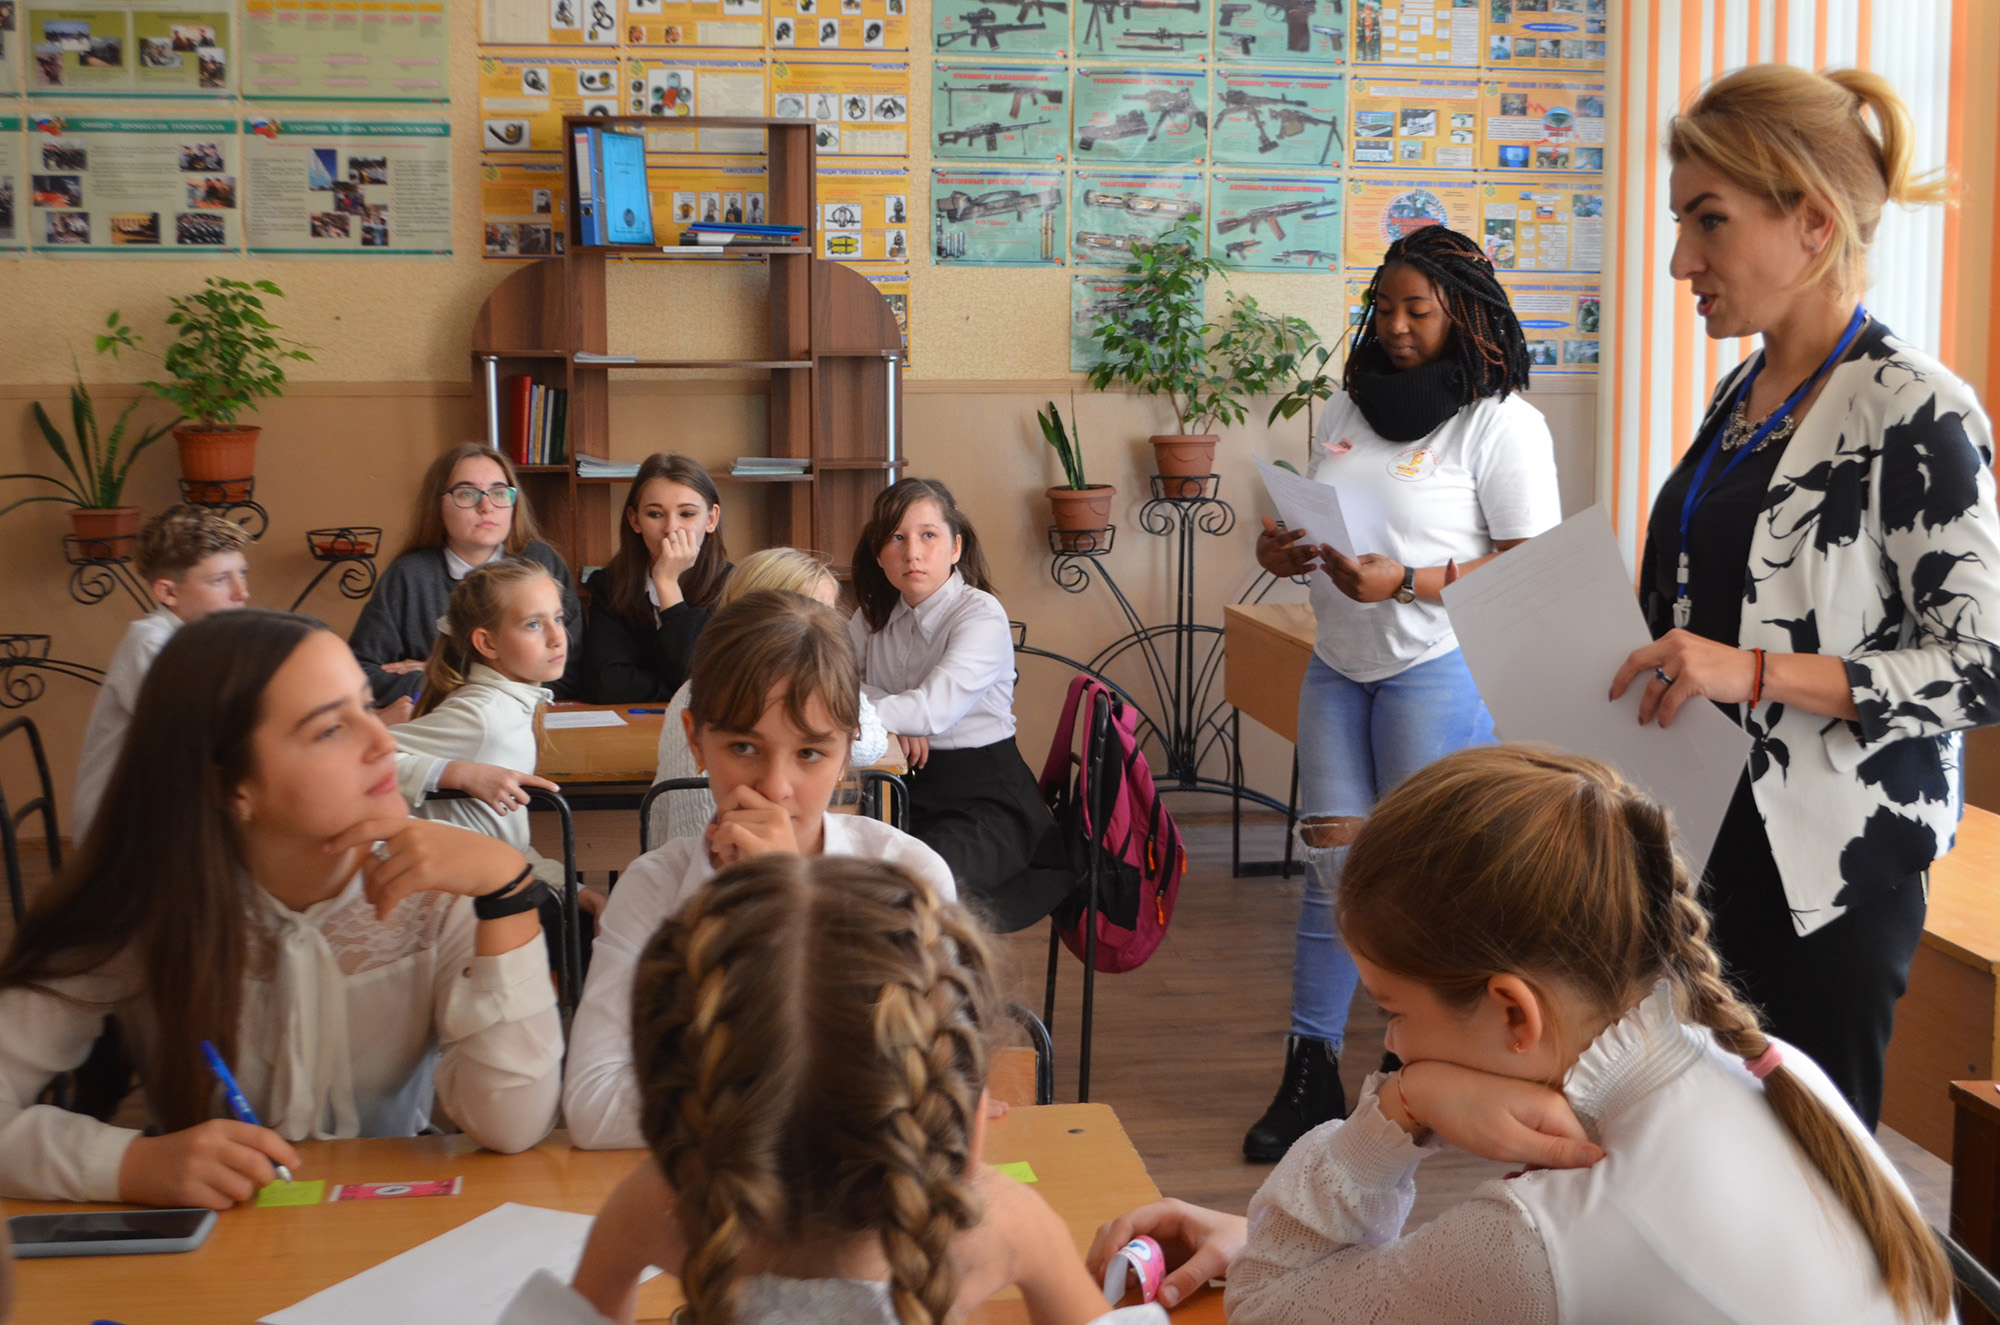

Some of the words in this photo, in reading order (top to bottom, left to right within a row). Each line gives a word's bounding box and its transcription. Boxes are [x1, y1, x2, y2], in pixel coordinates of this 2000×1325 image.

[953, 73, 992, 81] ПУЛЕМЕТЫ
[994, 74, 1049, 82] КАЛАШНИКОВА
[936, 178, 985, 186] РЕАКТИВНЫЕ
[1099, 181, 1148, 190] РЕАКТИВНЫЕ
[1228, 184, 1269, 192] АВТОМАТЫ
[1270, 185, 1326, 193] КАЛАШНИКОВА
